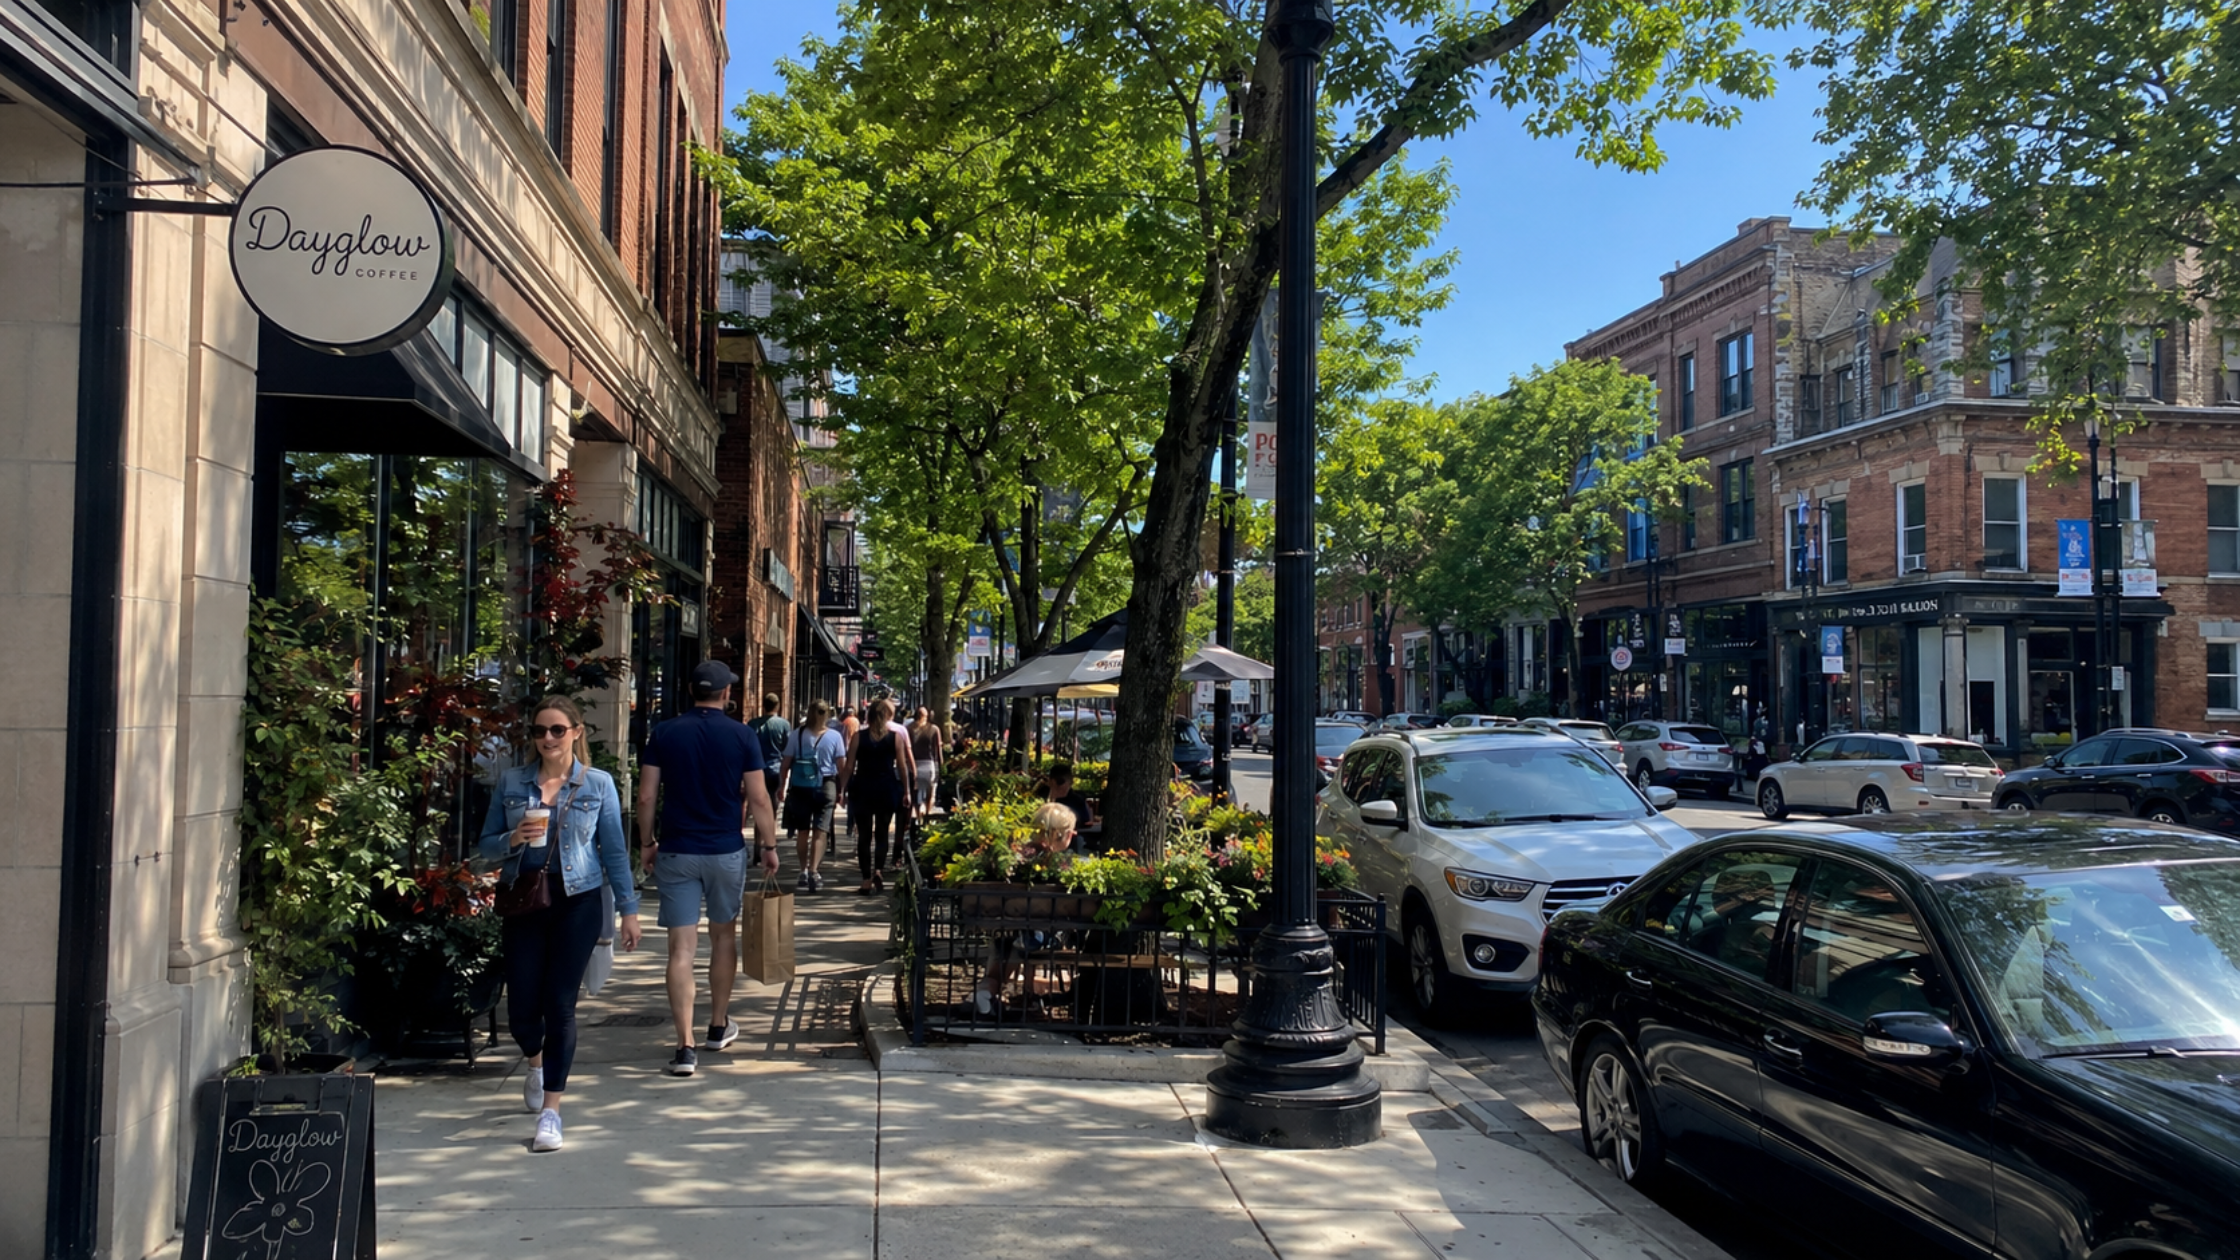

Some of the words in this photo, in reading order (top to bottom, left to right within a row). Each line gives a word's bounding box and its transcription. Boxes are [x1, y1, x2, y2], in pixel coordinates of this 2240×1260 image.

[245, 205, 431, 277] Dayglow
[355, 268, 418, 281] COFFEE
[228, 1118, 344, 1164] Dayglow
